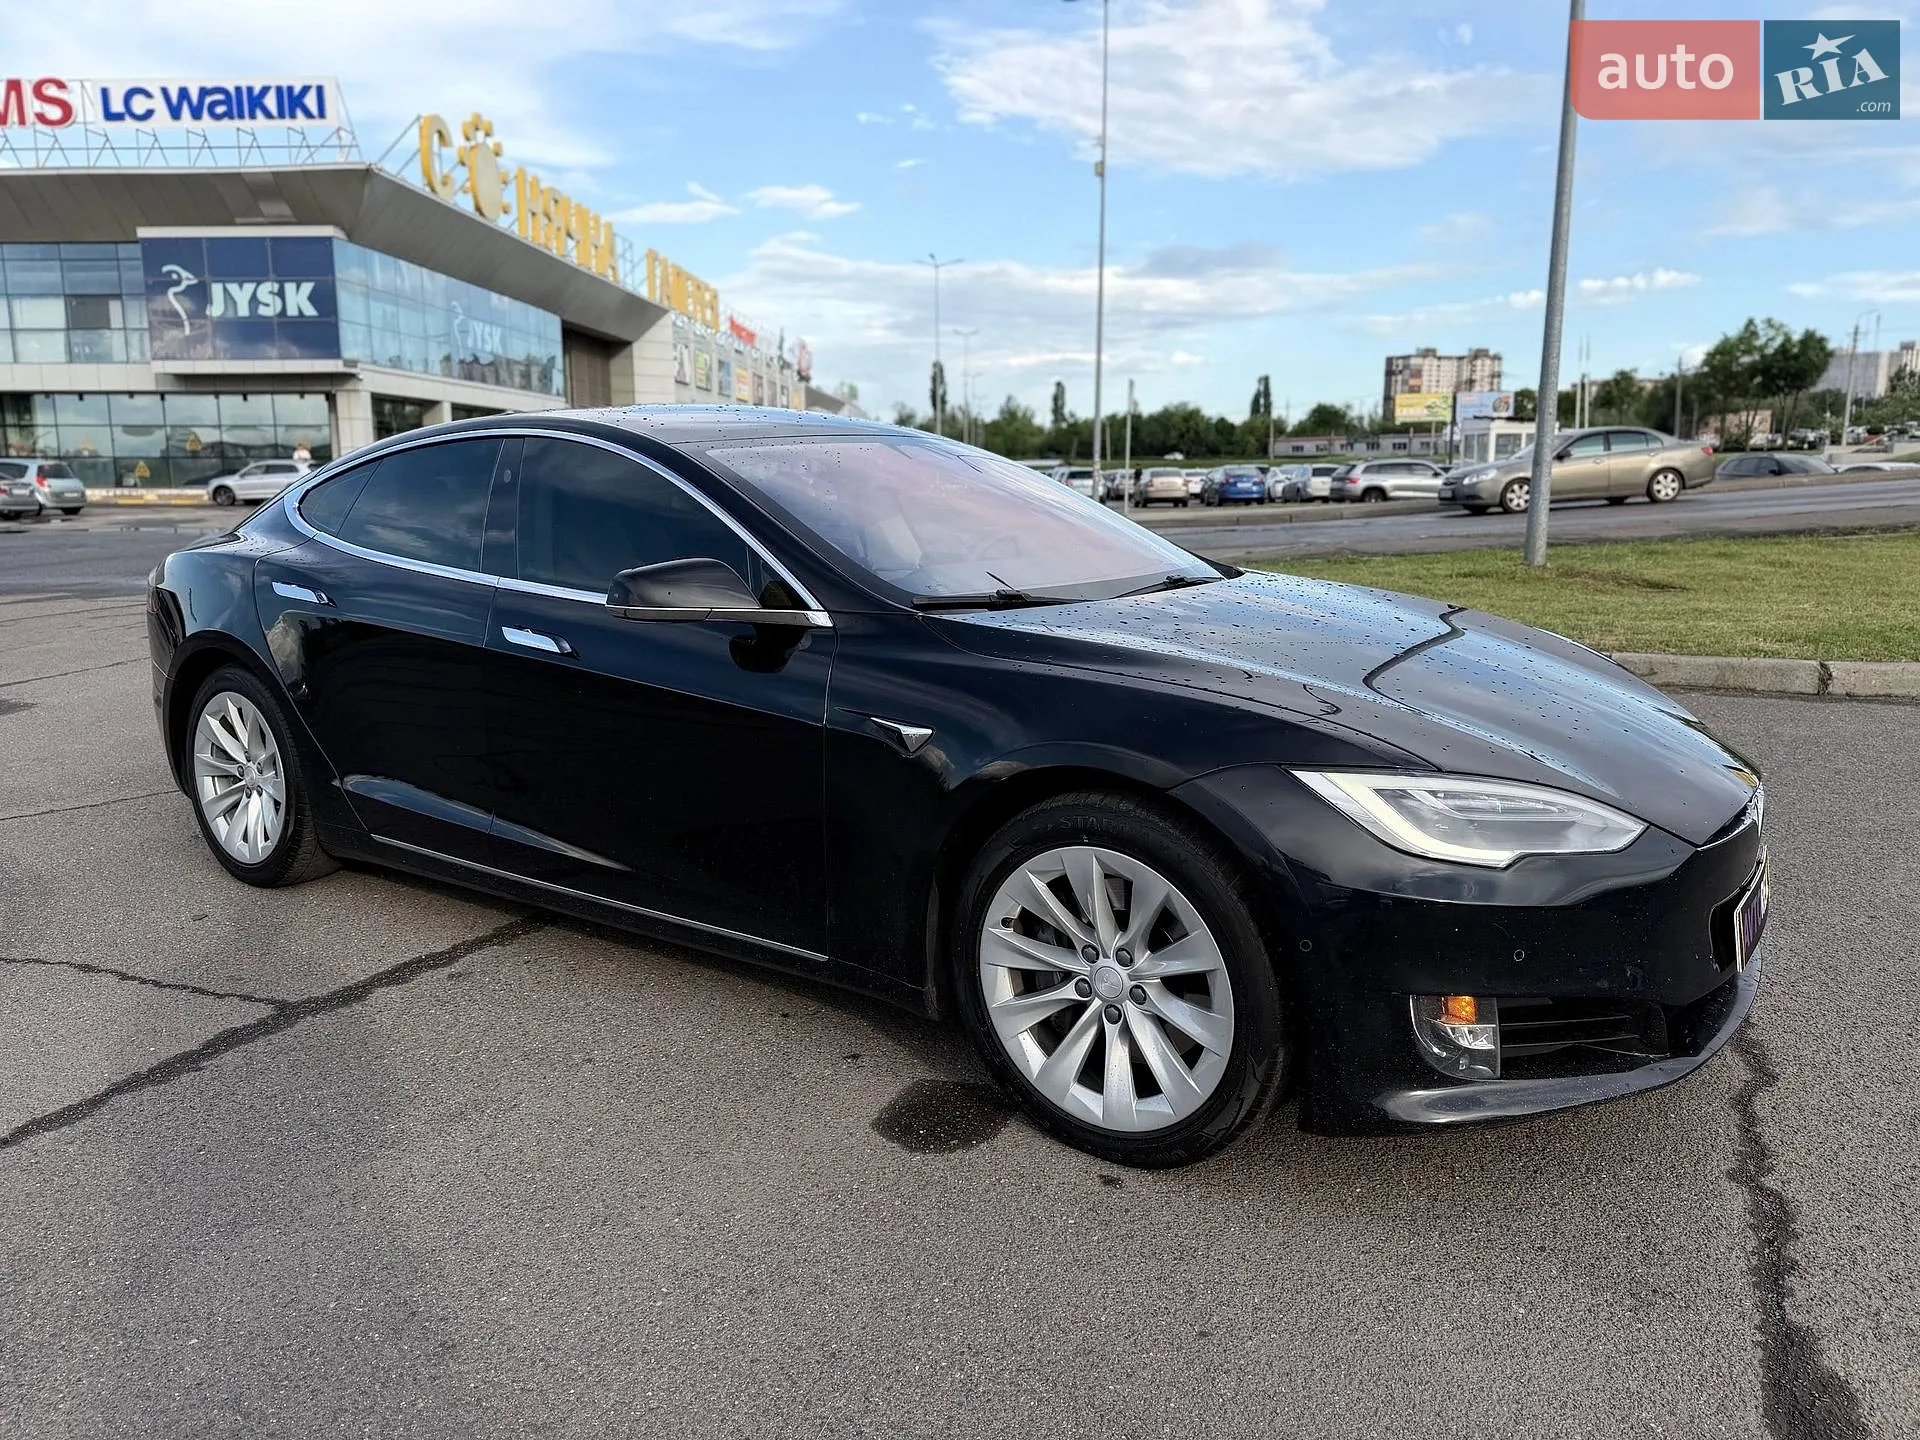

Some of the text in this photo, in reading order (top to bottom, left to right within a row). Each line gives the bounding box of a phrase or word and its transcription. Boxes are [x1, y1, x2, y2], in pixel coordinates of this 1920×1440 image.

[100, 87, 156, 122] LC
[205, 281, 319, 317] JYSK
[467, 320, 503, 353] JYSK
